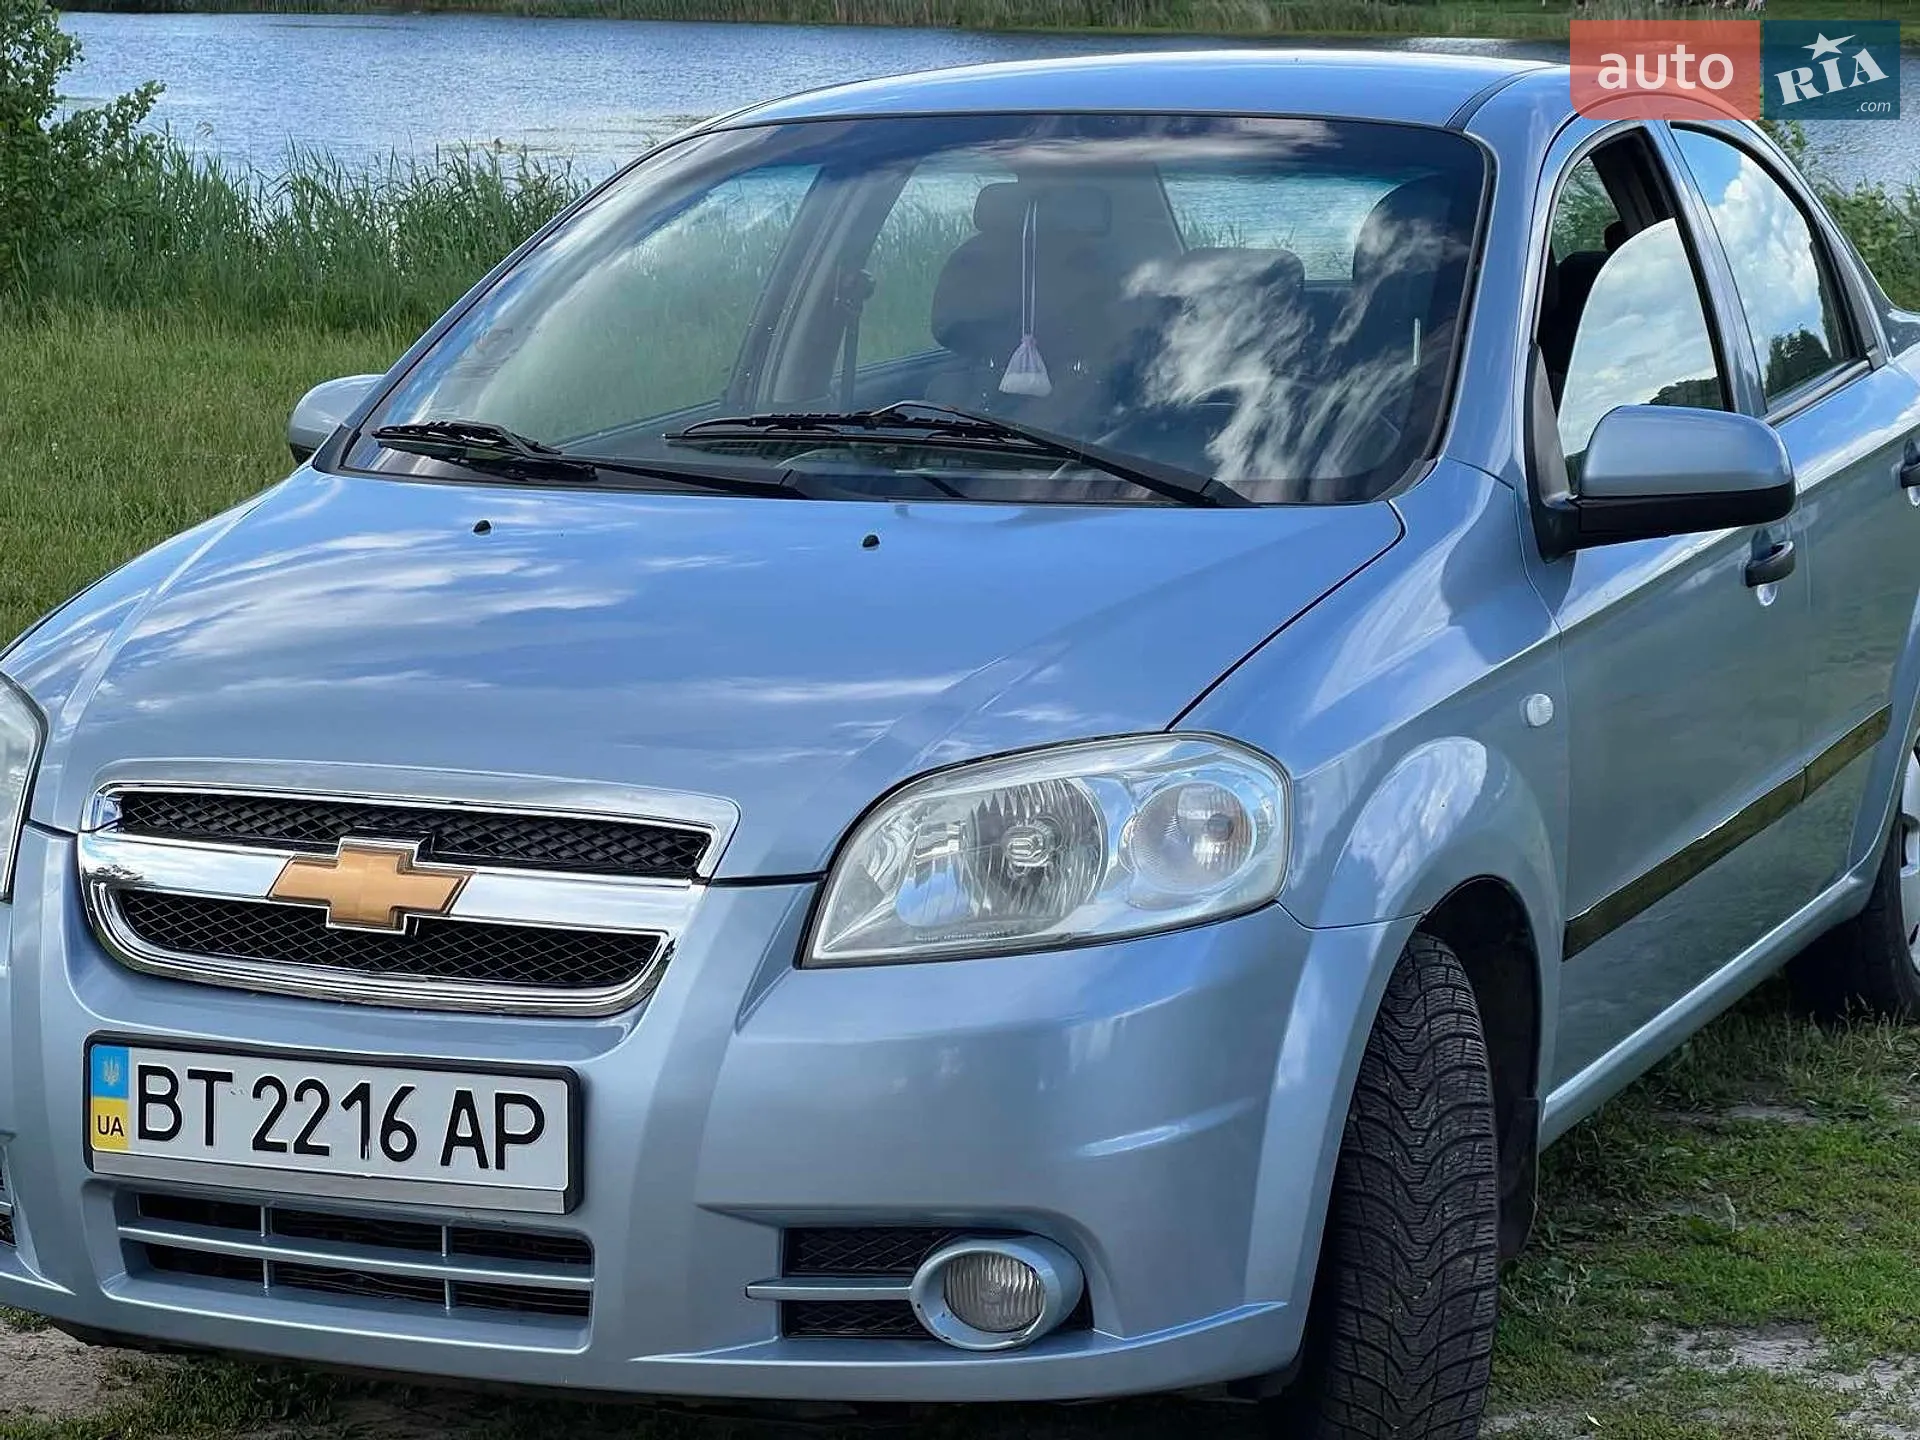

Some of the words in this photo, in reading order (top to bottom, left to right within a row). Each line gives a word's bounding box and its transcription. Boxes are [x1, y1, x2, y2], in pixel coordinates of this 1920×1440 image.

[97, 1115, 125, 1138] UA
[137, 1064, 234, 1146] BT
[251, 1075, 418, 1162] 2216
[440, 1089, 545, 1171] AP
